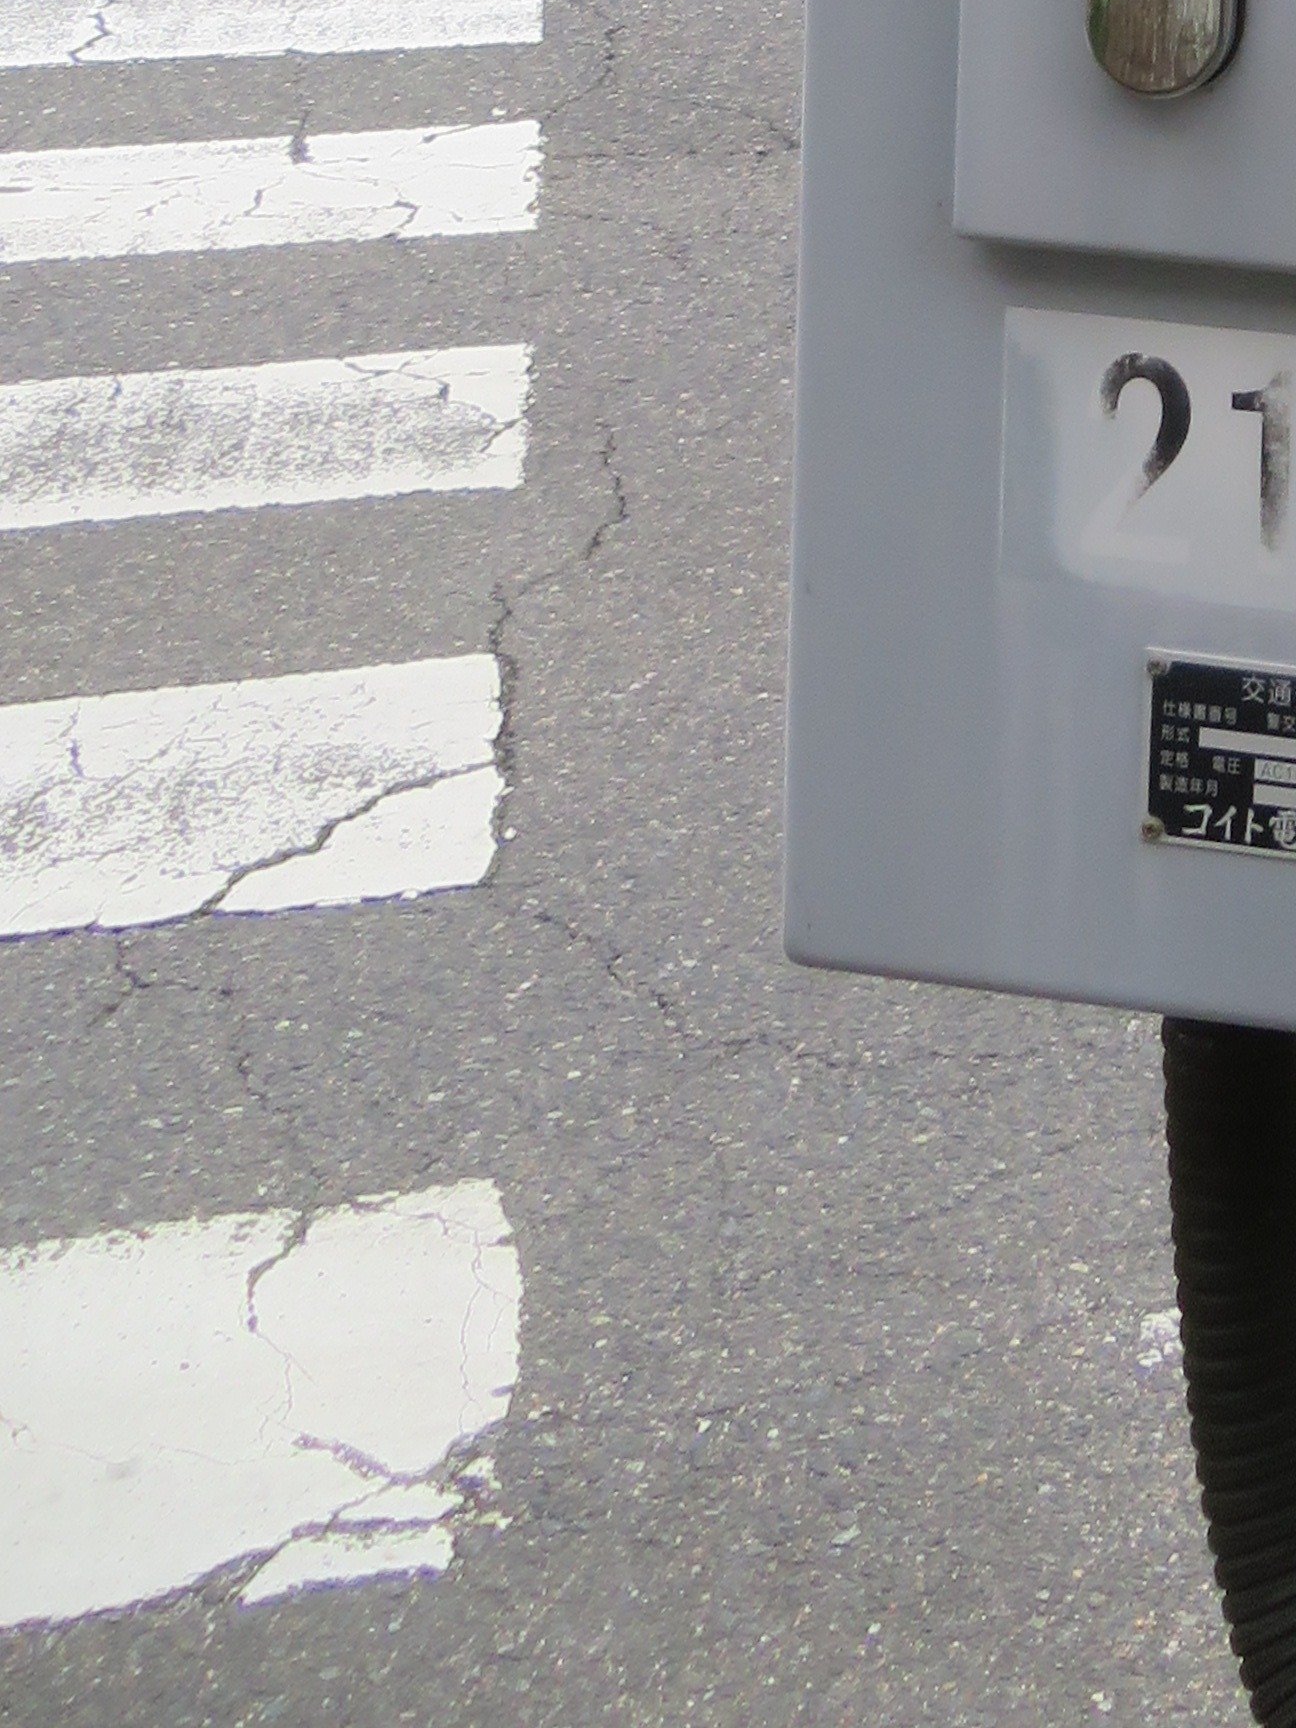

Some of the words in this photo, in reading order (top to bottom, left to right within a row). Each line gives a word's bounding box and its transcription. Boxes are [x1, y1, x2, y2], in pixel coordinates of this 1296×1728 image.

[1160, 723, 1191, 743] 形式
[1160, 749, 1190, 769] 定格
[1211, 754, 1242, 775] 電圧
